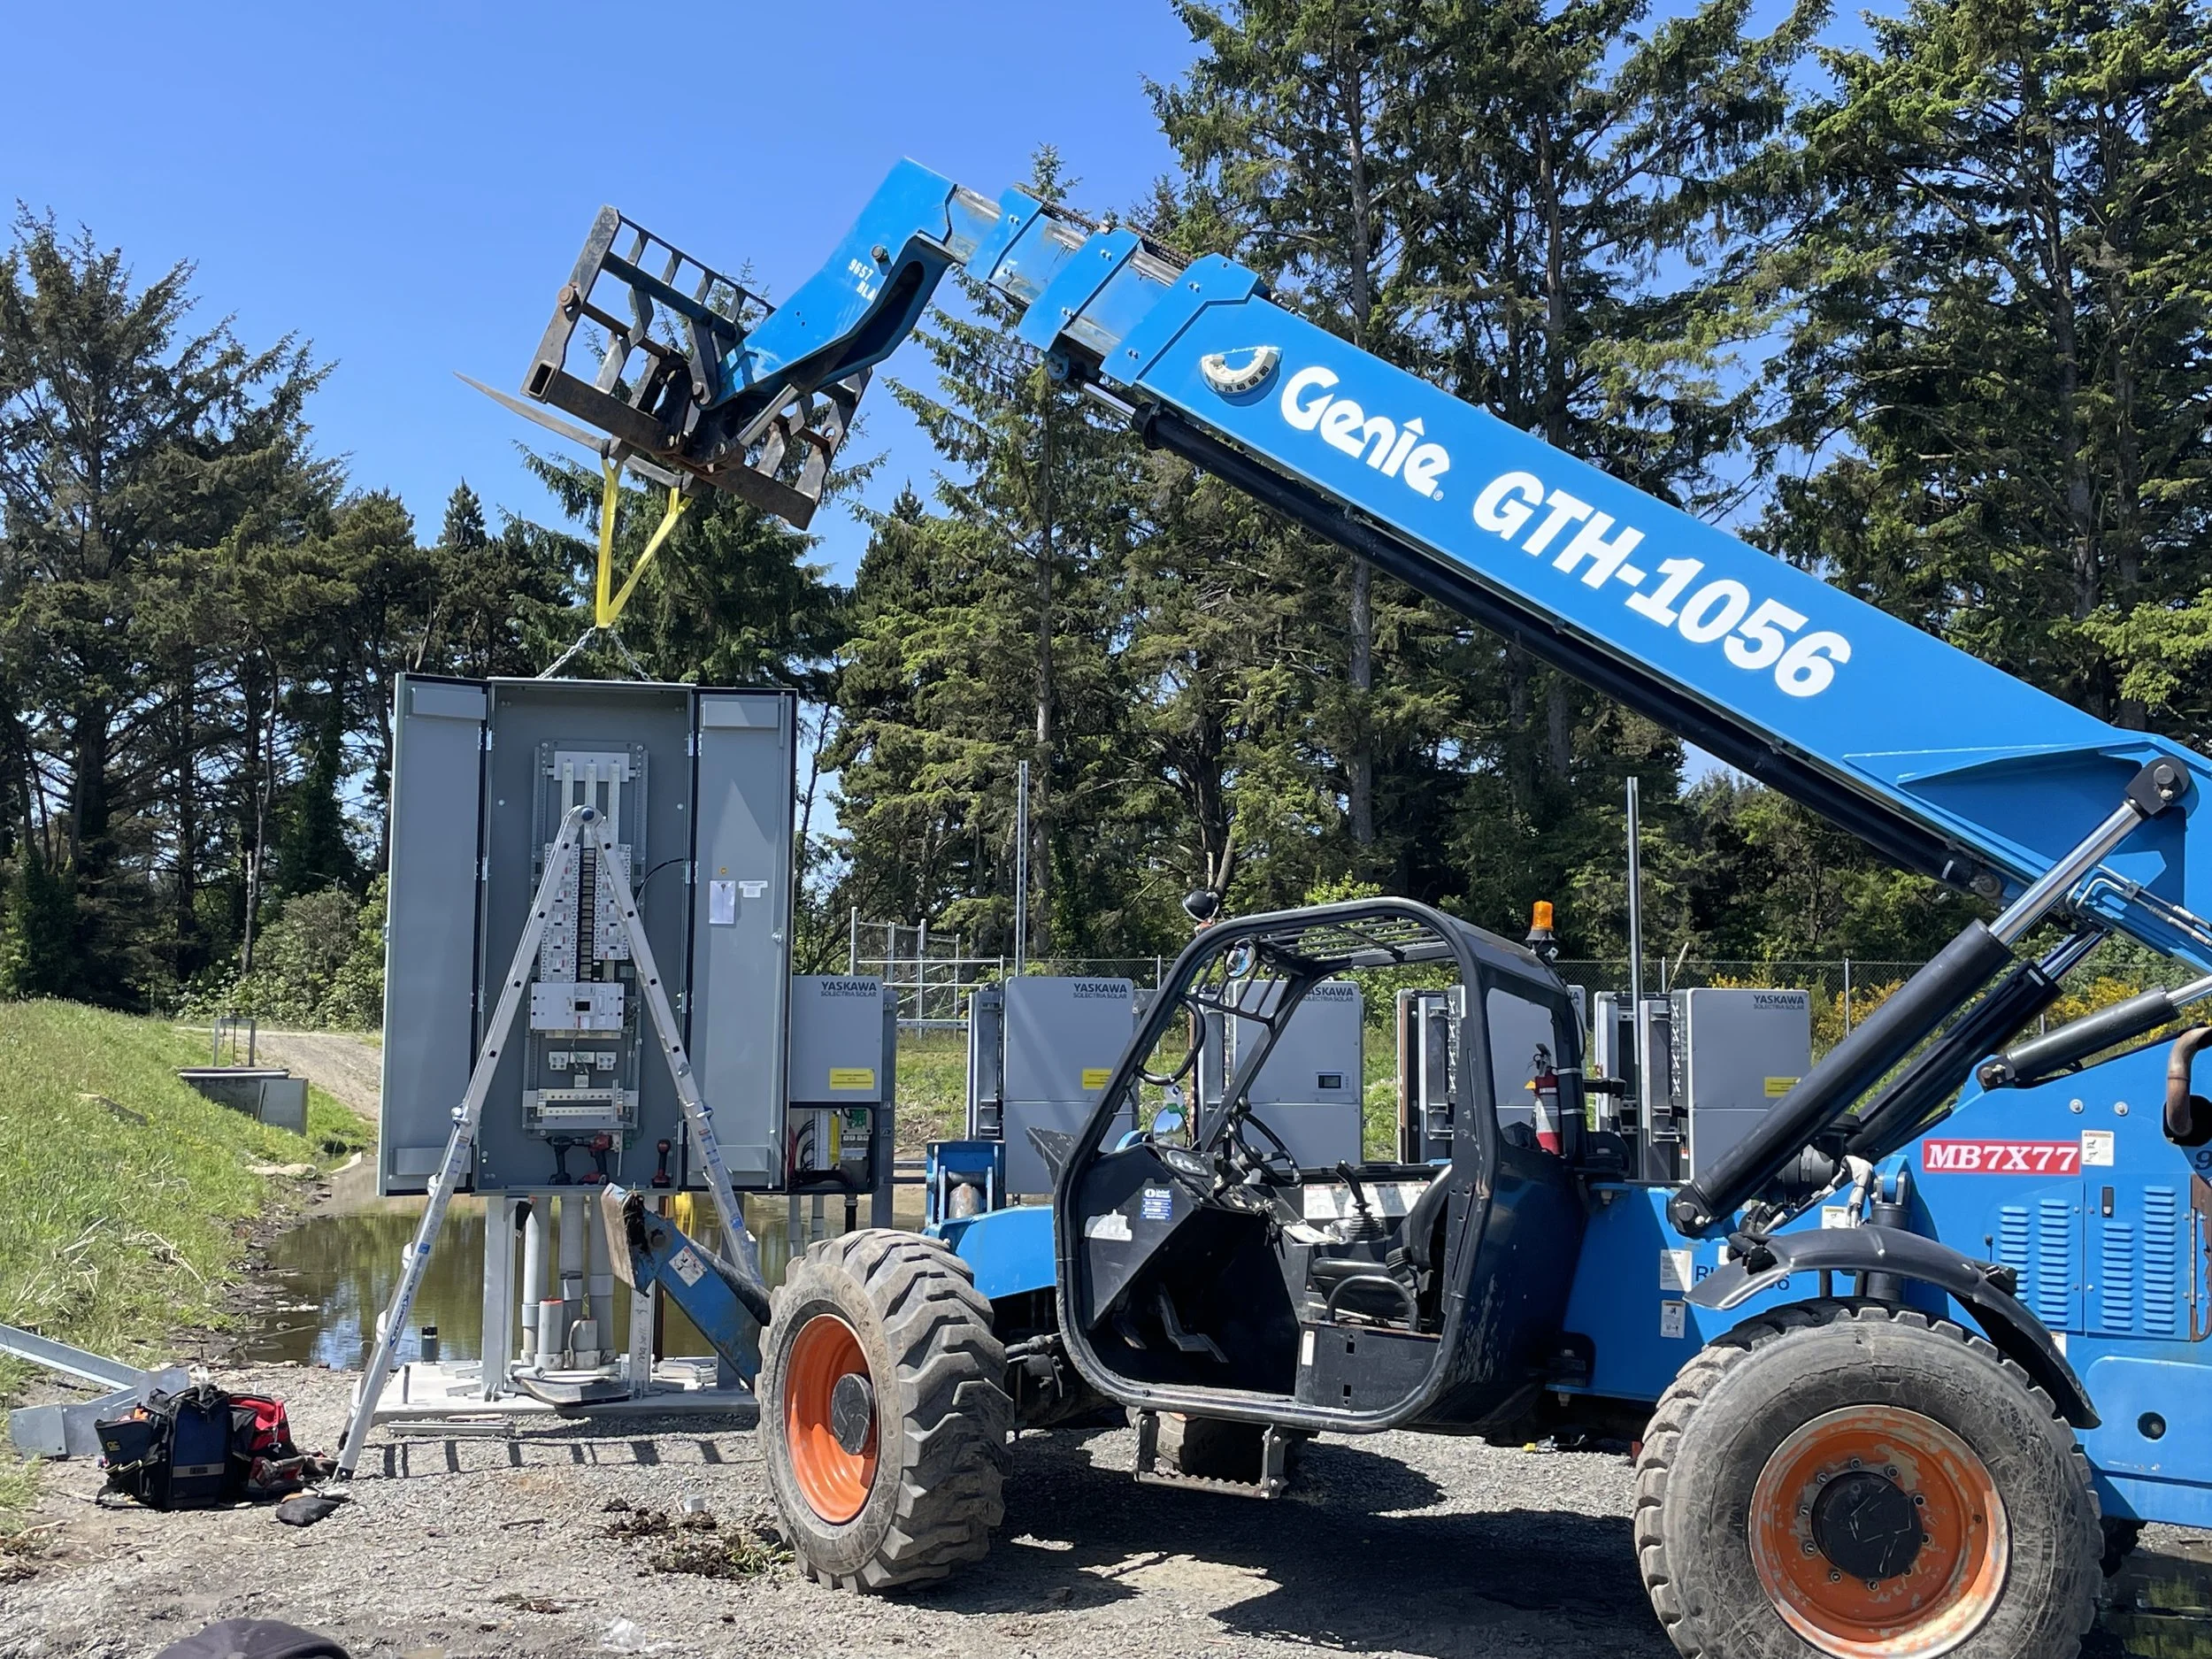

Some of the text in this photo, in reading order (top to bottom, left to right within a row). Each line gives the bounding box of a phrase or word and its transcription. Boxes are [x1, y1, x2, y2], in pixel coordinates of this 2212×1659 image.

[849, 258, 874, 281] 9657
[1472, 471, 1852, 698] GTH-1056
[821, 981, 877, 991] YASKAWA
[1073, 983, 1127, 993] YASKAWA
[1309, 987, 1354, 996] ASKAWA
[1754, 995, 1804, 1004] YASKAWA
[1926, 1144, 2078, 1171] MB7X77
